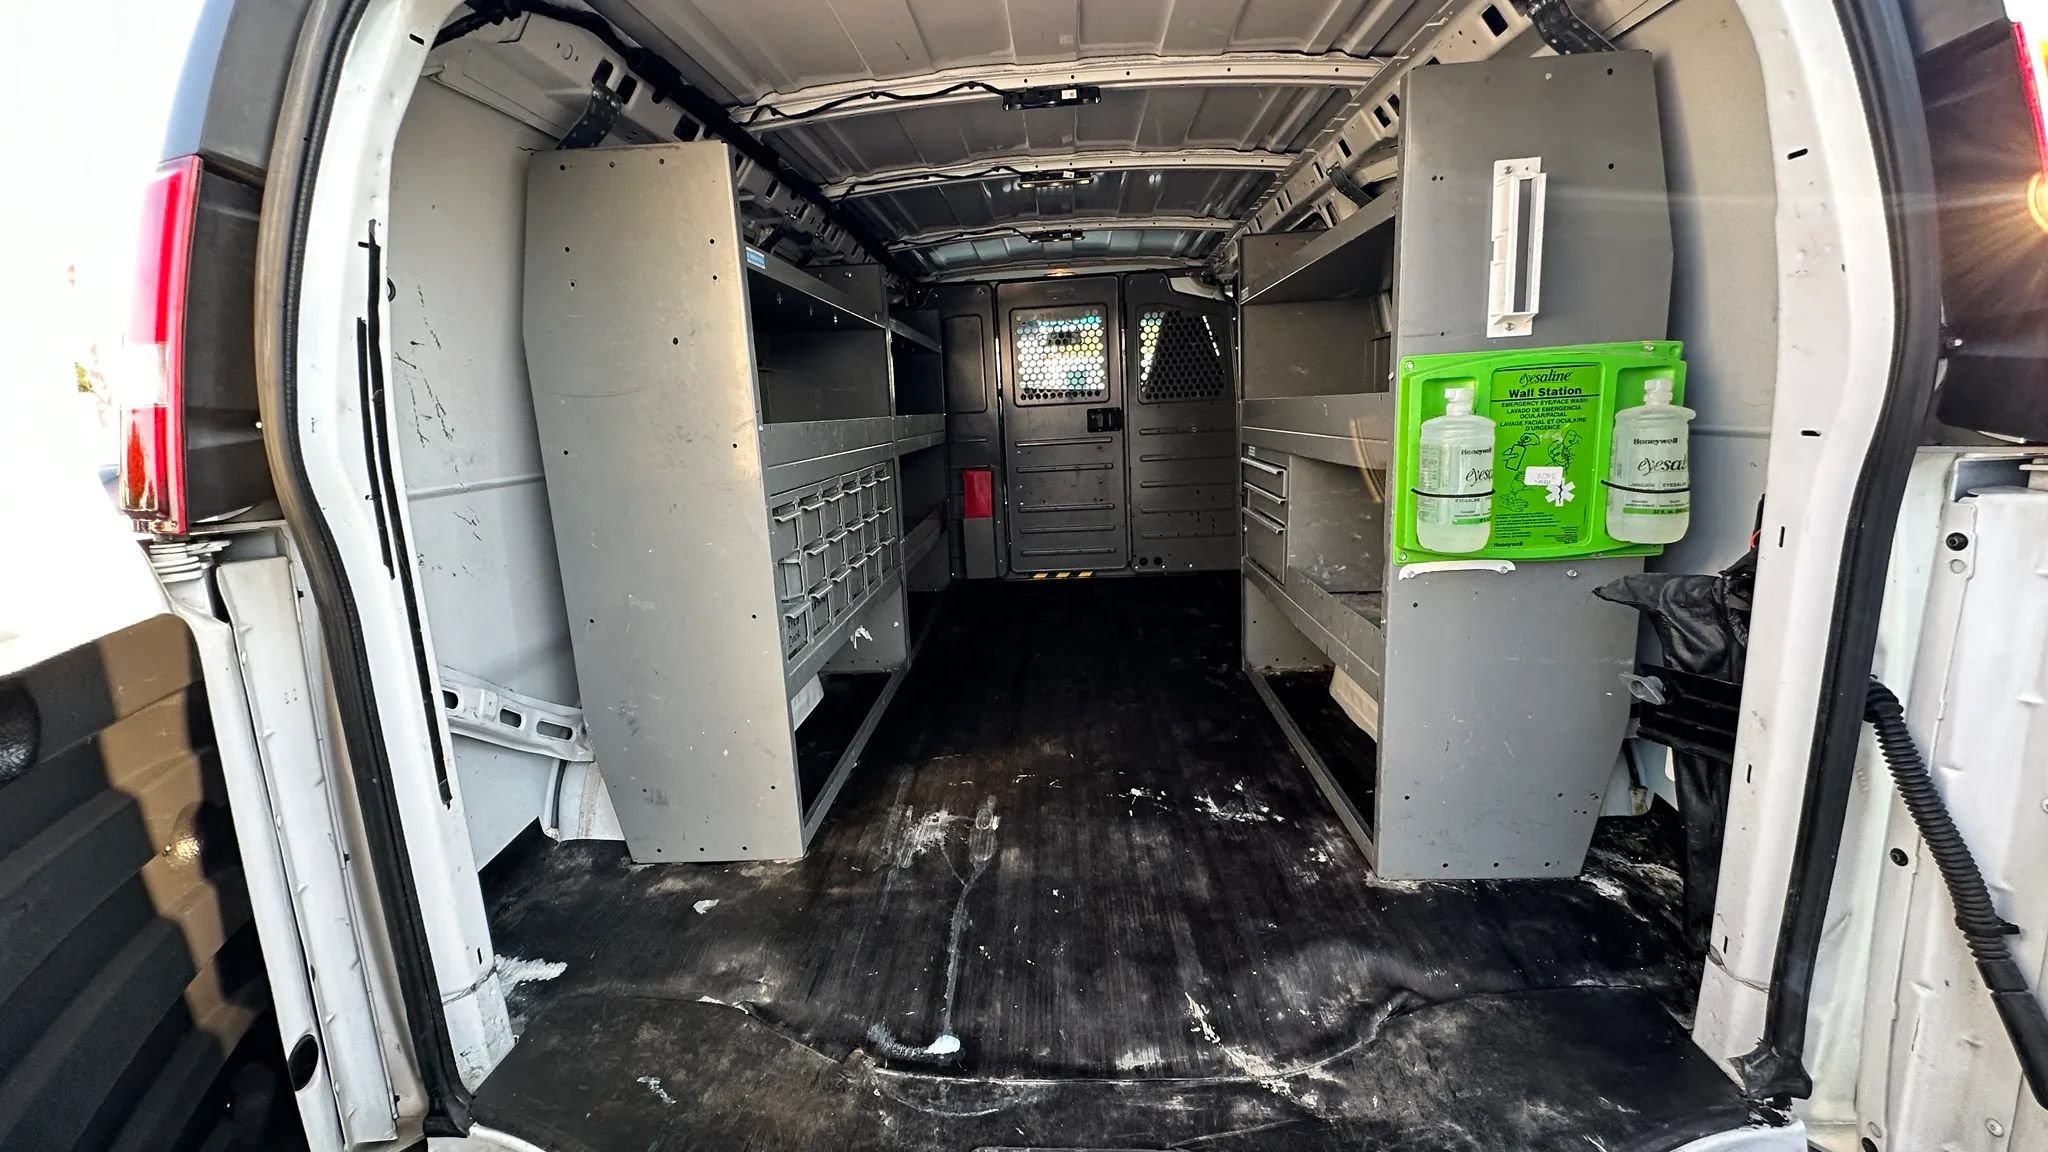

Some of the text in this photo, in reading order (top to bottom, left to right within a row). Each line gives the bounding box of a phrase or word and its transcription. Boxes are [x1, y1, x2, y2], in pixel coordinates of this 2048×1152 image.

[1519, 369, 1573, 387] eyesaline
[1508, 386, 1582, 398] Wall Station
[1541, 404, 1581, 412] EMERGENCIA
[1633, 437, 1678, 446] Honeywell
